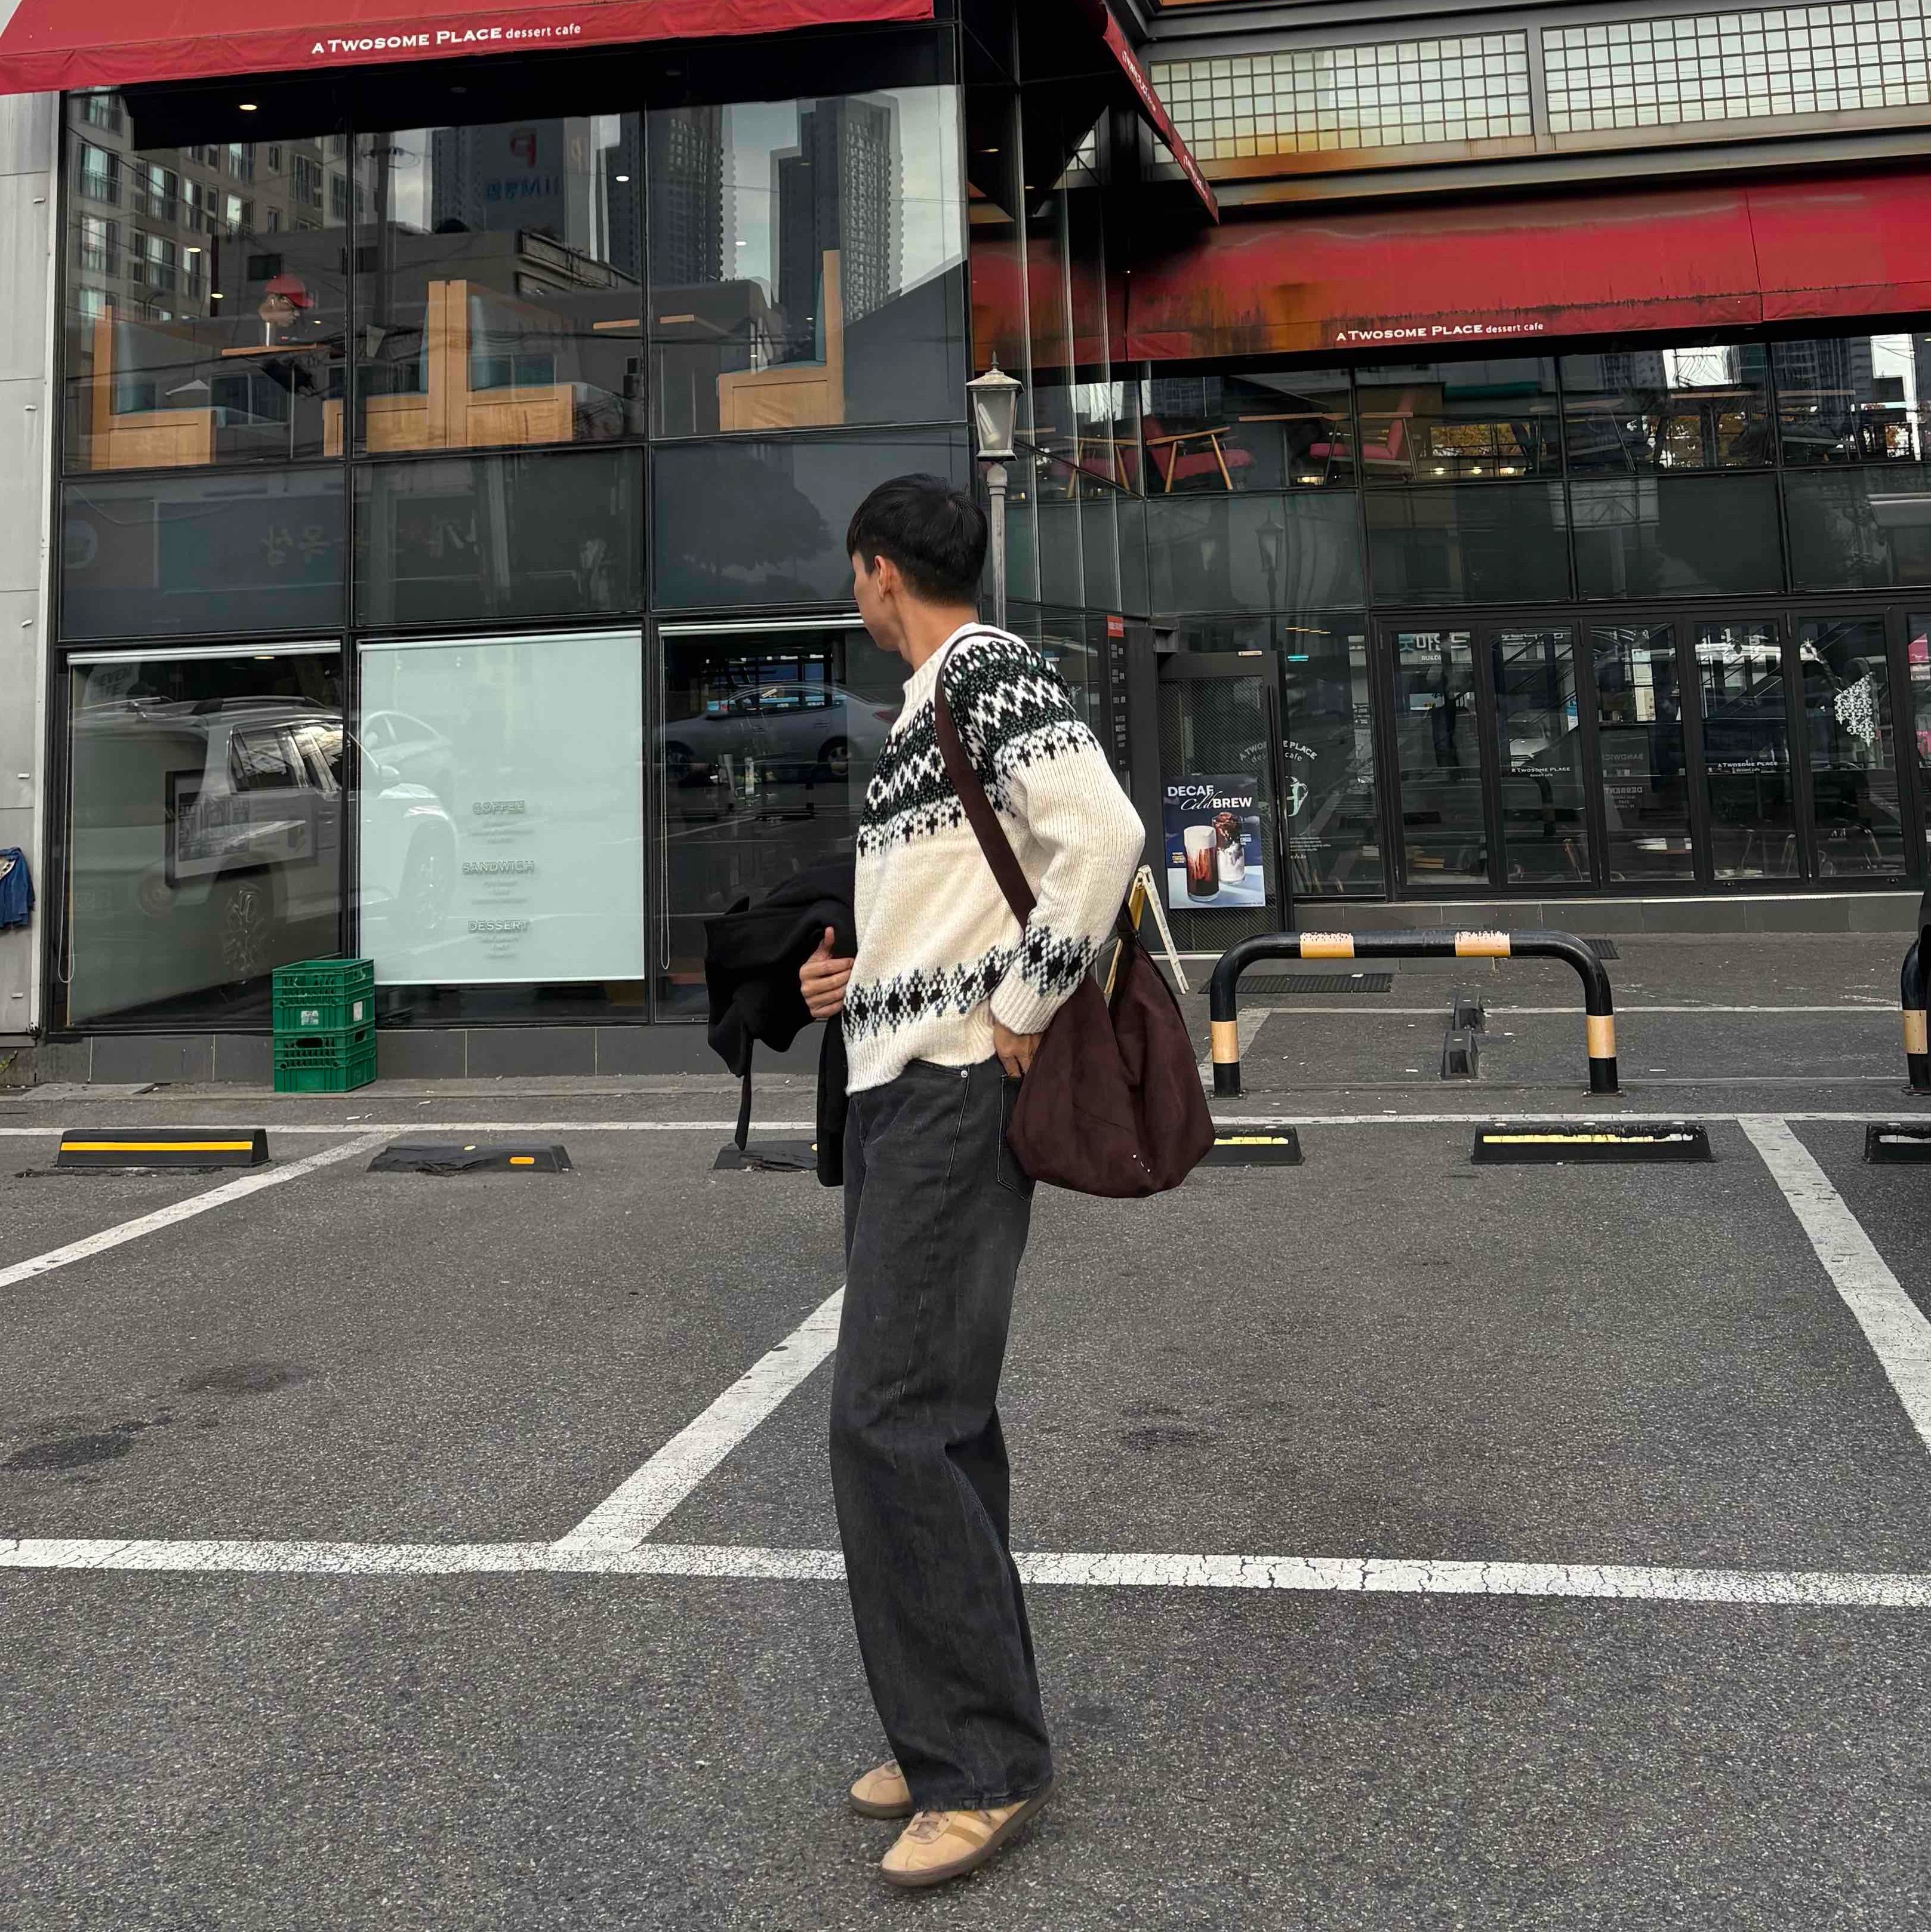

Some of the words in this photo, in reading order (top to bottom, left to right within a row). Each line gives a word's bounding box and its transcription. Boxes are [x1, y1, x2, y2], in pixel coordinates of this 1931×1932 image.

[312, 42, 325, 54] A
[327, 34, 430, 53] TWOSOME
[436, 27, 502, 45] PLACE
[506, 25, 552, 39] dessert
[555, 23, 581, 36] cafe
[1336, 332, 1346, 341] A
[1348, 328, 1427, 341] TWOSOME
[1431, 325, 1483, 336] PLACE
[1485, 323, 1521, 334] dessert
[1523, 322, 1544, 331] cafe
[1289, 741, 1317, 760] PLACE
[1168, 785, 1214, 797] DECAF
[472, 800, 525, 815] COFFEE
[1213, 796, 1252, 809] BREW
[462, 859, 535, 875] SANDWICH
[467, 920, 529, 933] DESSERT
